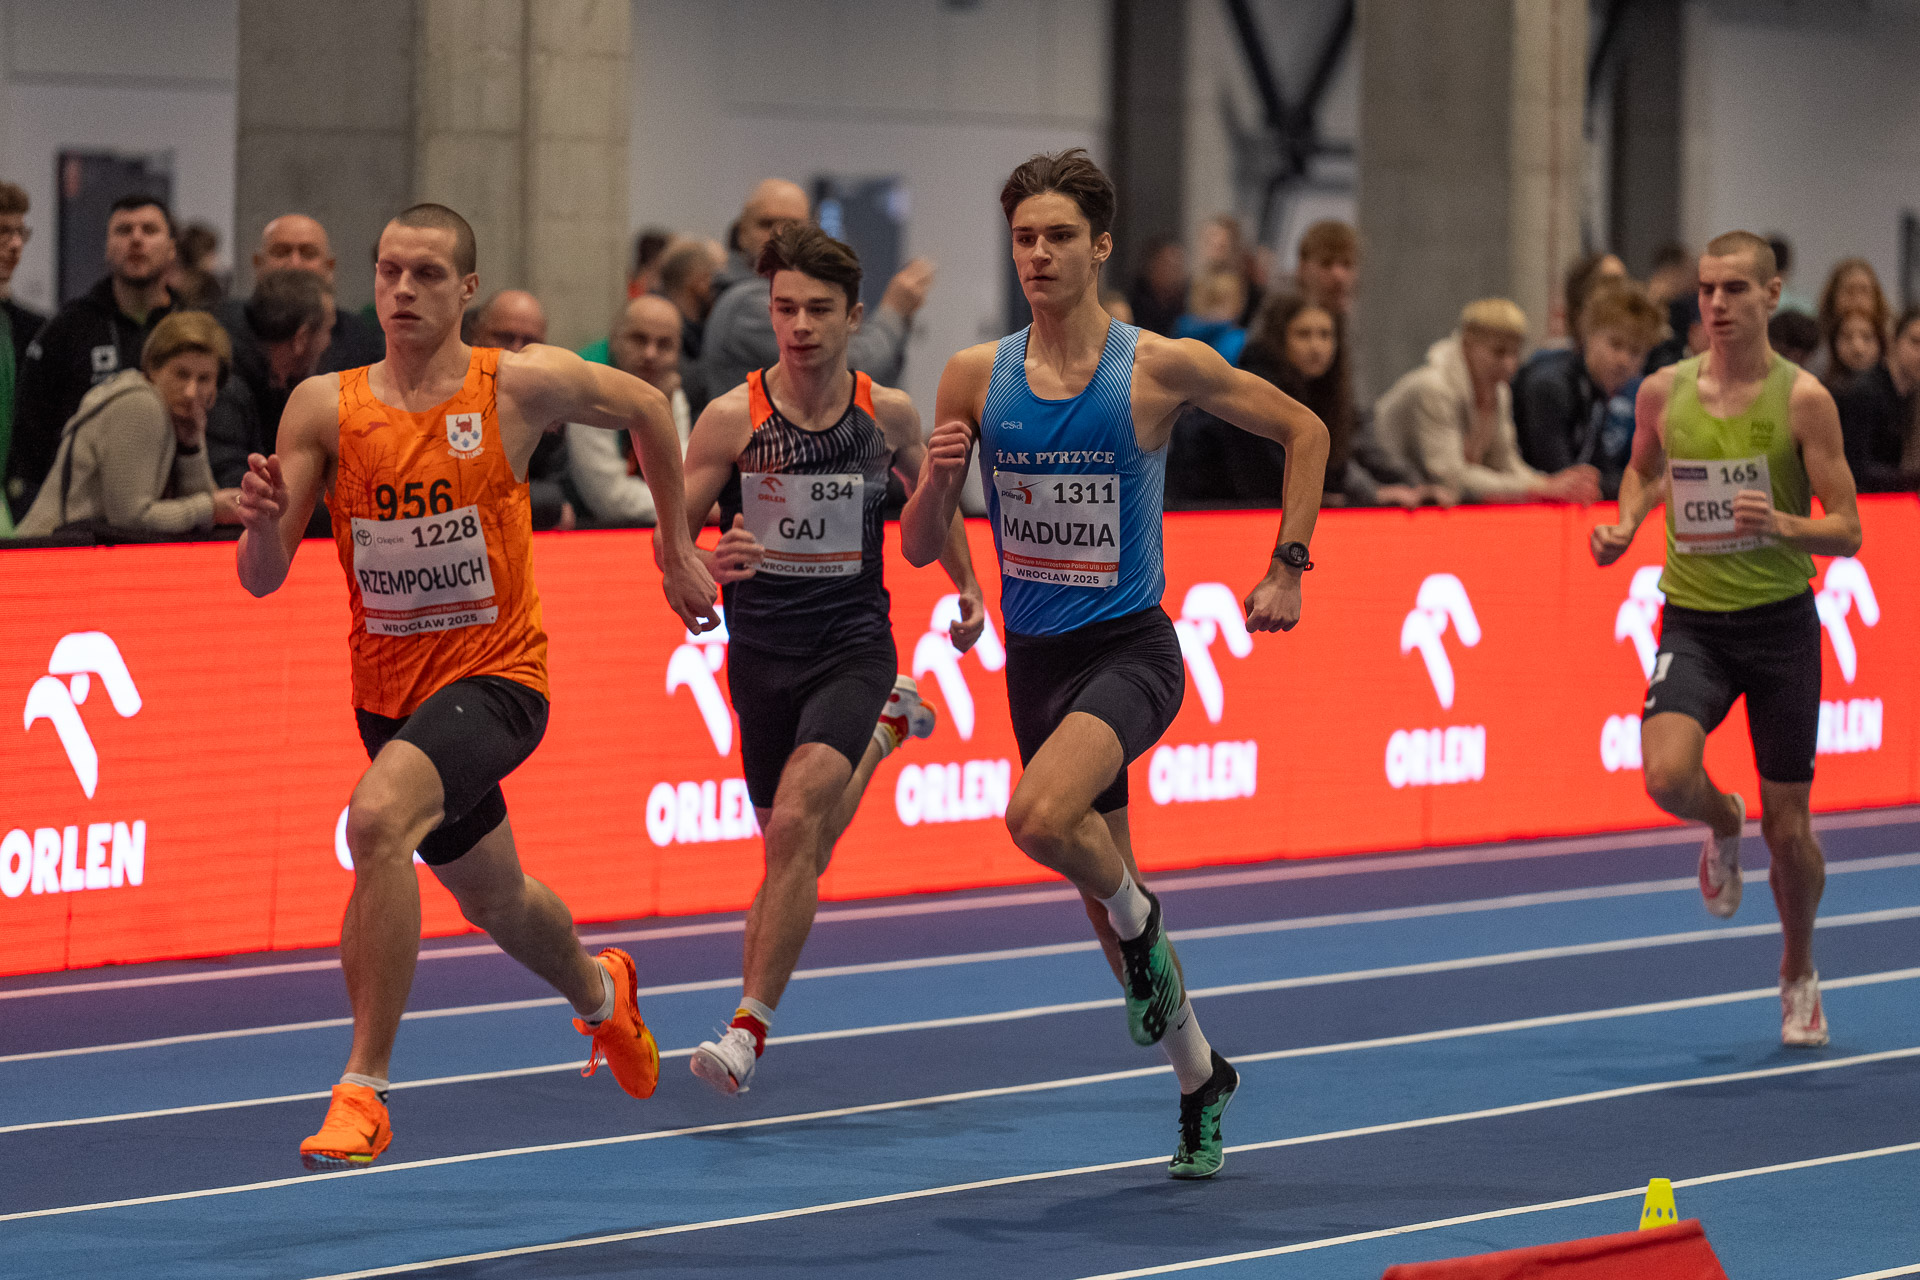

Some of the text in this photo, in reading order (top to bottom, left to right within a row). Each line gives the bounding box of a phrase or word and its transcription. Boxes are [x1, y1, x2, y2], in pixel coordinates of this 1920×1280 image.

[996, 449, 1115, 465] ŻAK PYRZYCE
[1720, 463, 1758, 485] 165
[375, 478, 454, 521] 956
[758, 493, 786, 503] ORLEN
[811, 481, 854, 502] 834
[1001, 489, 1024, 502] polanik
[1053, 482, 1116, 504] 1311
[1684, 500, 1734, 522] CERS
[411, 515, 478, 549] 1228
[778, 517, 826, 540] GAJ
[1003, 514, 1116, 548] MADUZIA
[358, 556, 486, 596] RZEMPOŁUCH
[760, 562, 844, 574] WROCŁAW 2025
[1015, 567, 1100, 585] WROCŁAW 2025
[1071, 562, 1089, 570] Polski
[382, 613, 478, 633] WROCŁAW 2025
[1817, 699, 1883, 753] RLEN
[1386, 725, 1486, 789] ORLEN
[1148, 740, 1258, 805] ORLEN
[895, 759, 1011, 826] ORLEN
[0, 819, 147, 898] ORLEN
